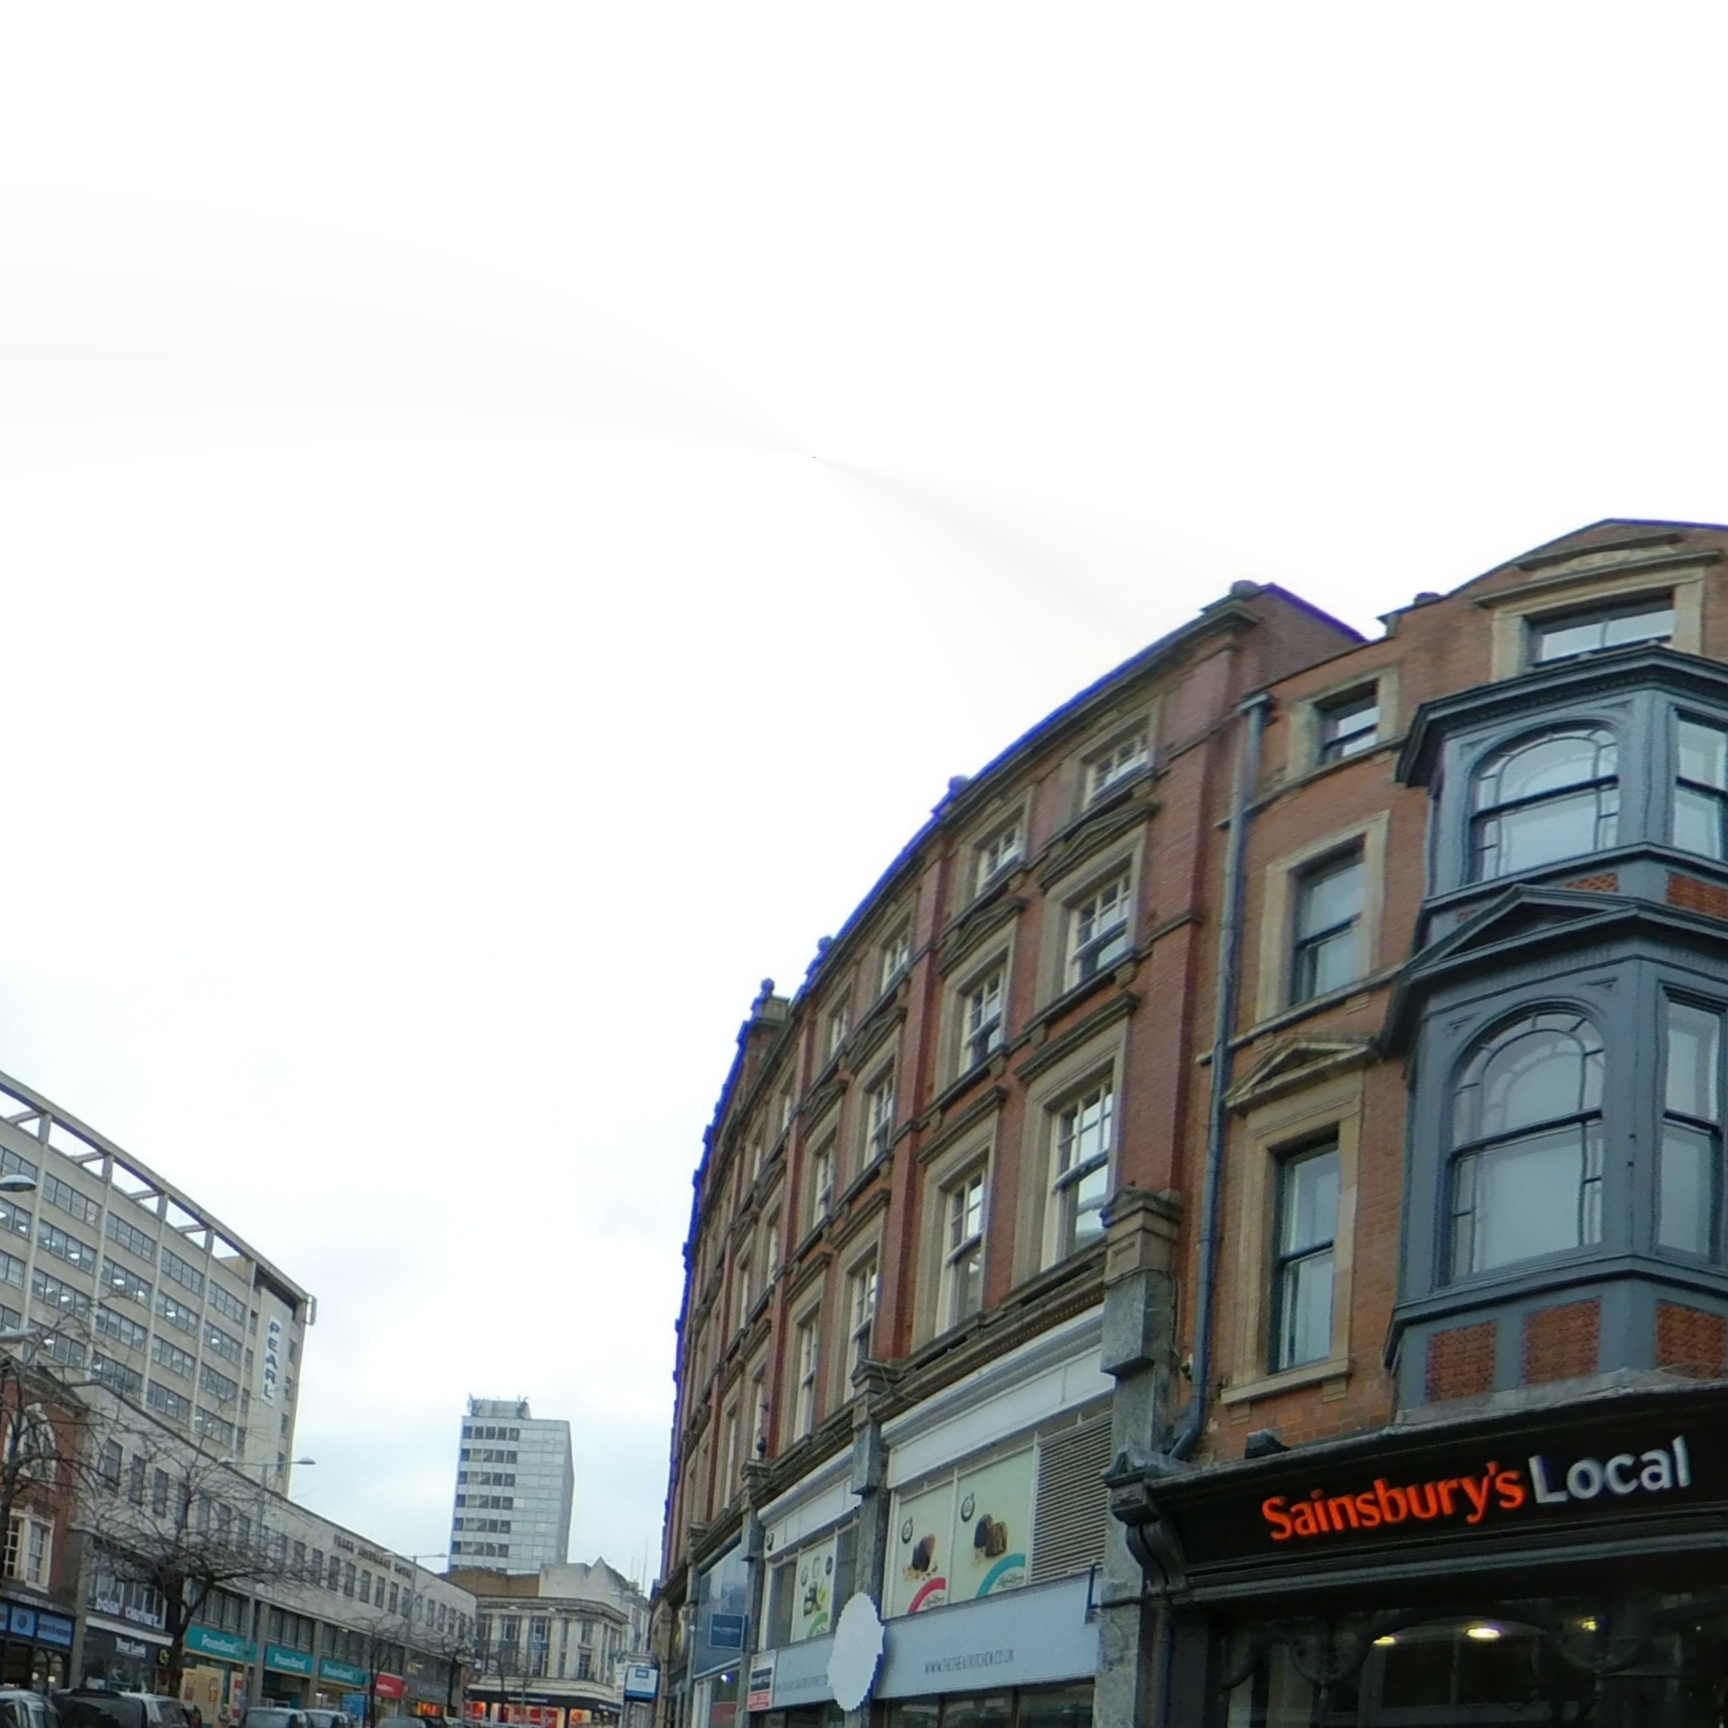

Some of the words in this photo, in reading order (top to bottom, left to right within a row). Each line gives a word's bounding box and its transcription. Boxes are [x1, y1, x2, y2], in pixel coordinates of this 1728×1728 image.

[263, 1320, 281, 1400] PEARL
[1261, 1461, 1525, 1541] Sainsbury's
[1528, 1434, 1692, 1505] Local
